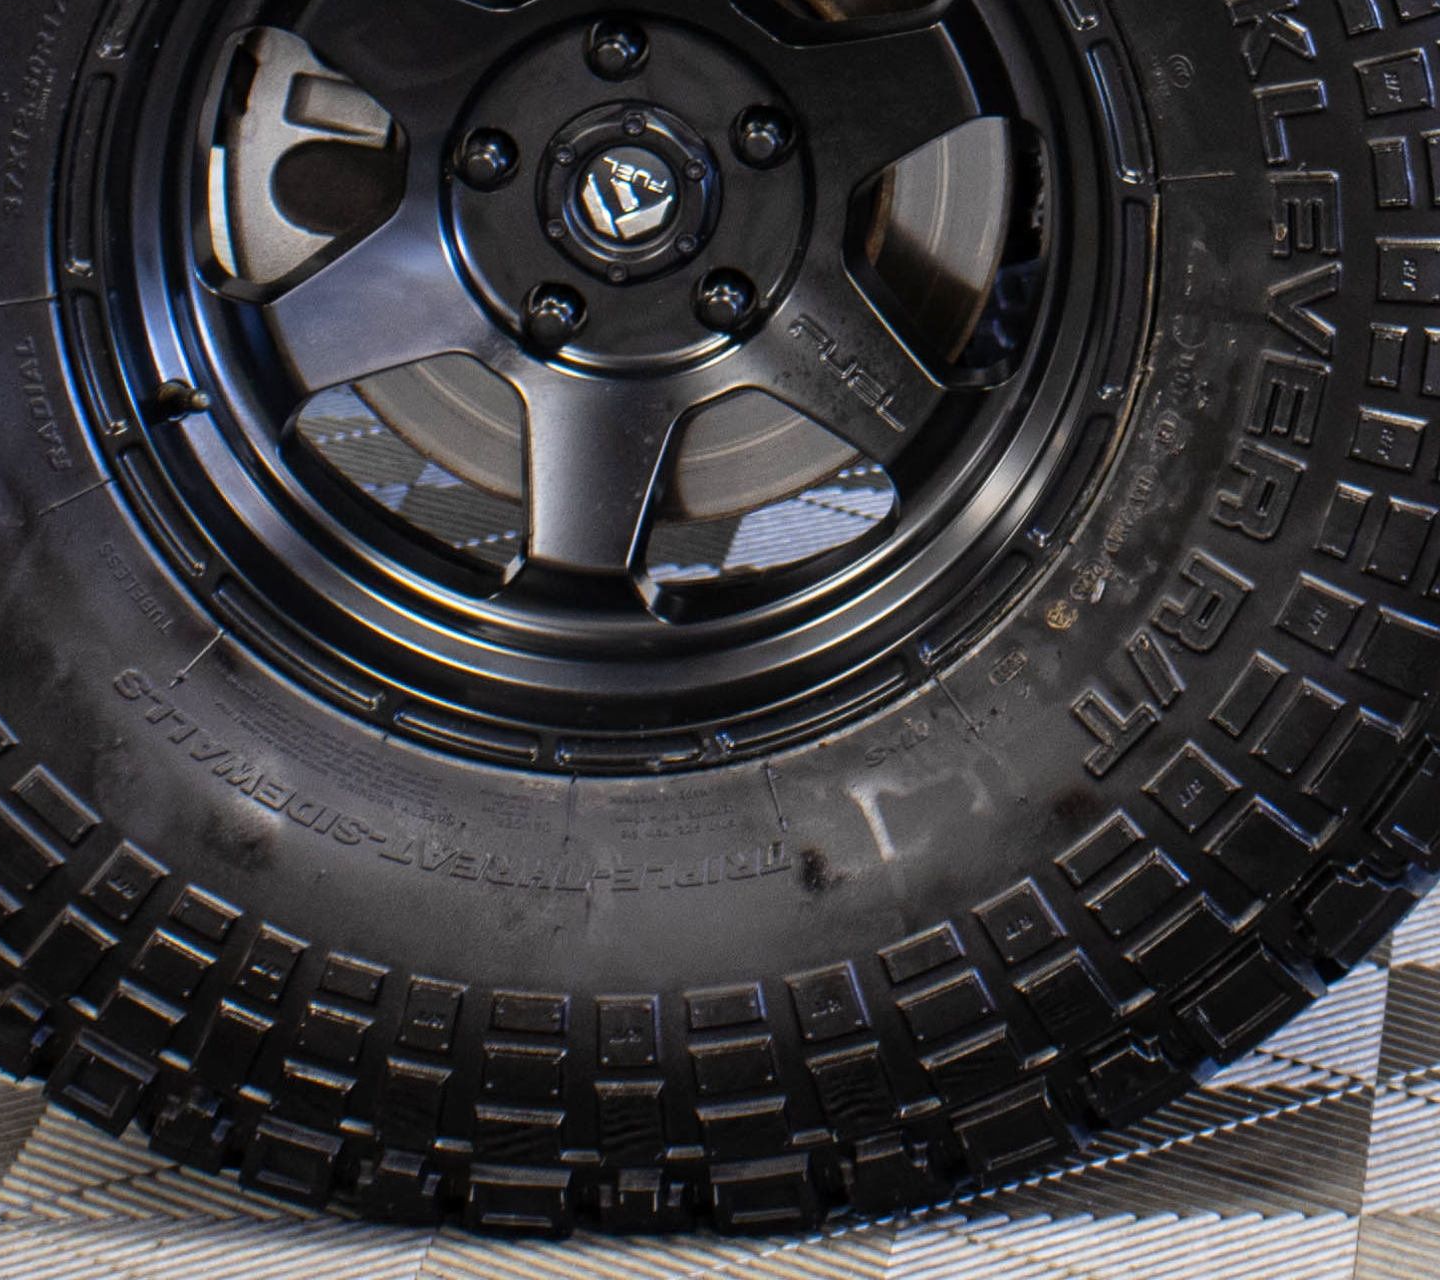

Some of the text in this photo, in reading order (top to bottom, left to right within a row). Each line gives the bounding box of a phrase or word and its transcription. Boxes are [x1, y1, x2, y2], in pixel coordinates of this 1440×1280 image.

[602, 156, 668, 194] FUEL
[20, 336, 74, 471] RADIAL
[787, 313, 908, 433] FUEL
[99, 541, 173, 634] TUBELESS
[1069, 551, 1257, 777] R/T
